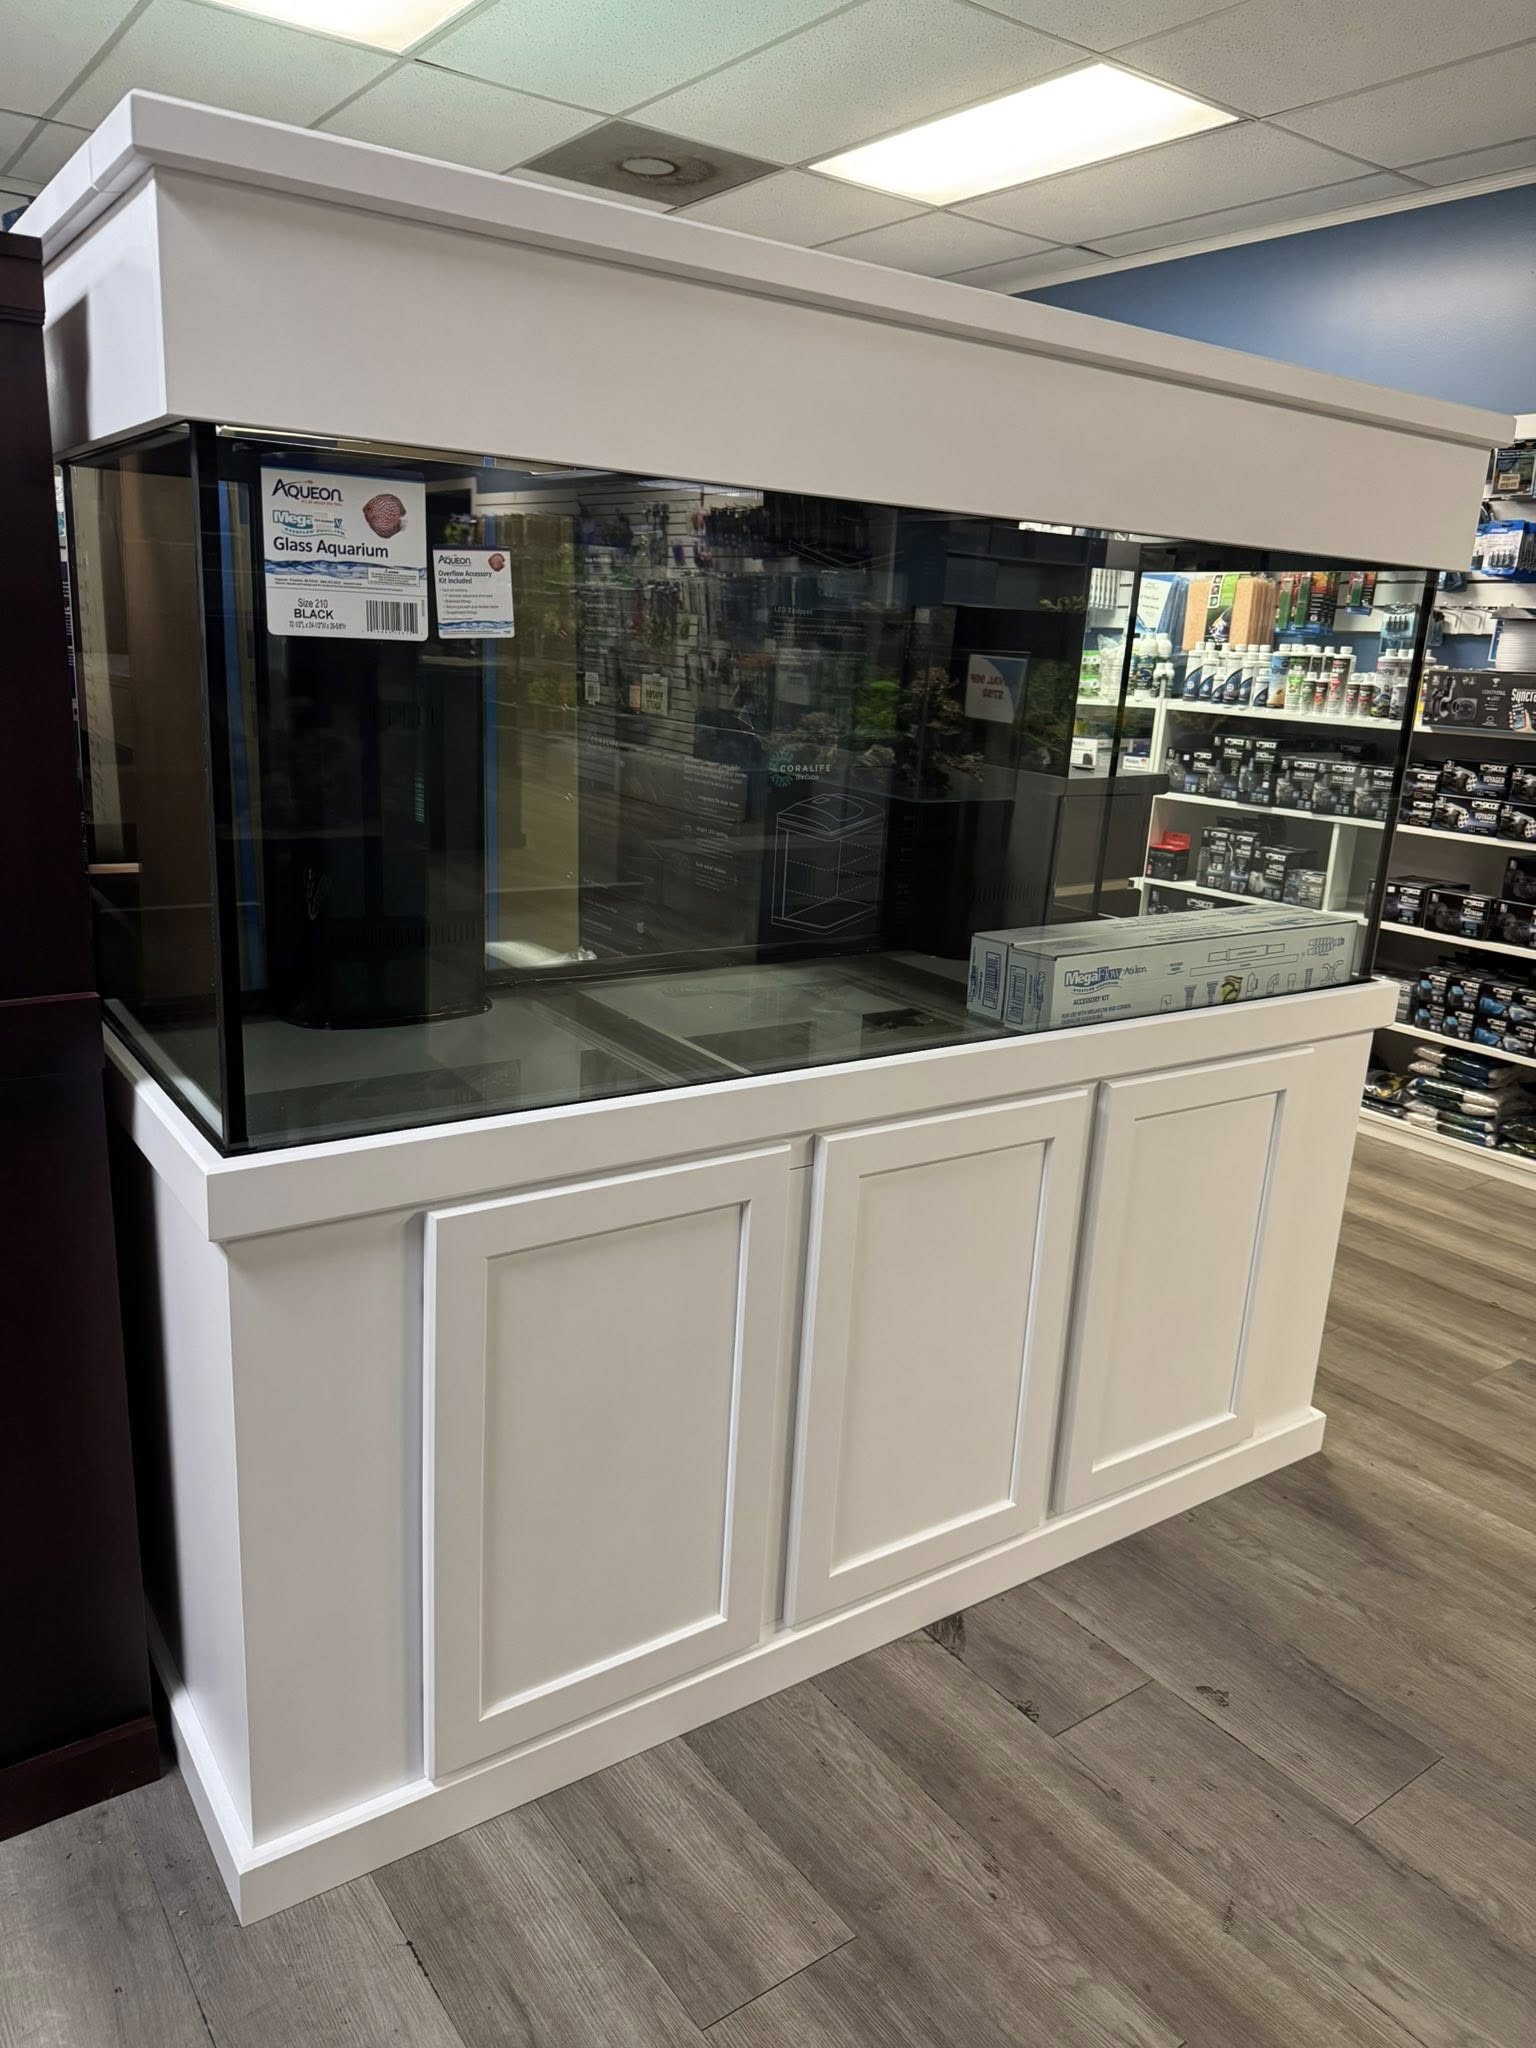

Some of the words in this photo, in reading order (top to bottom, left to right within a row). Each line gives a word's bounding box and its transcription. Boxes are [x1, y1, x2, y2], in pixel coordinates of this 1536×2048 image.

[273, 536, 313, 552] Glass
[316, 539, 389, 558] Aquarium
[465, 570, 493, 578] Accessory
[448, 577, 473, 585] Included
[297, 598, 314, 609] Size
[314, 598, 329, 609] 210
[294, 608, 335, 620] BLACK
[780, 764, 832, 773] CORALIFE
[1064, 966, 1122, 987] MegaFlow
